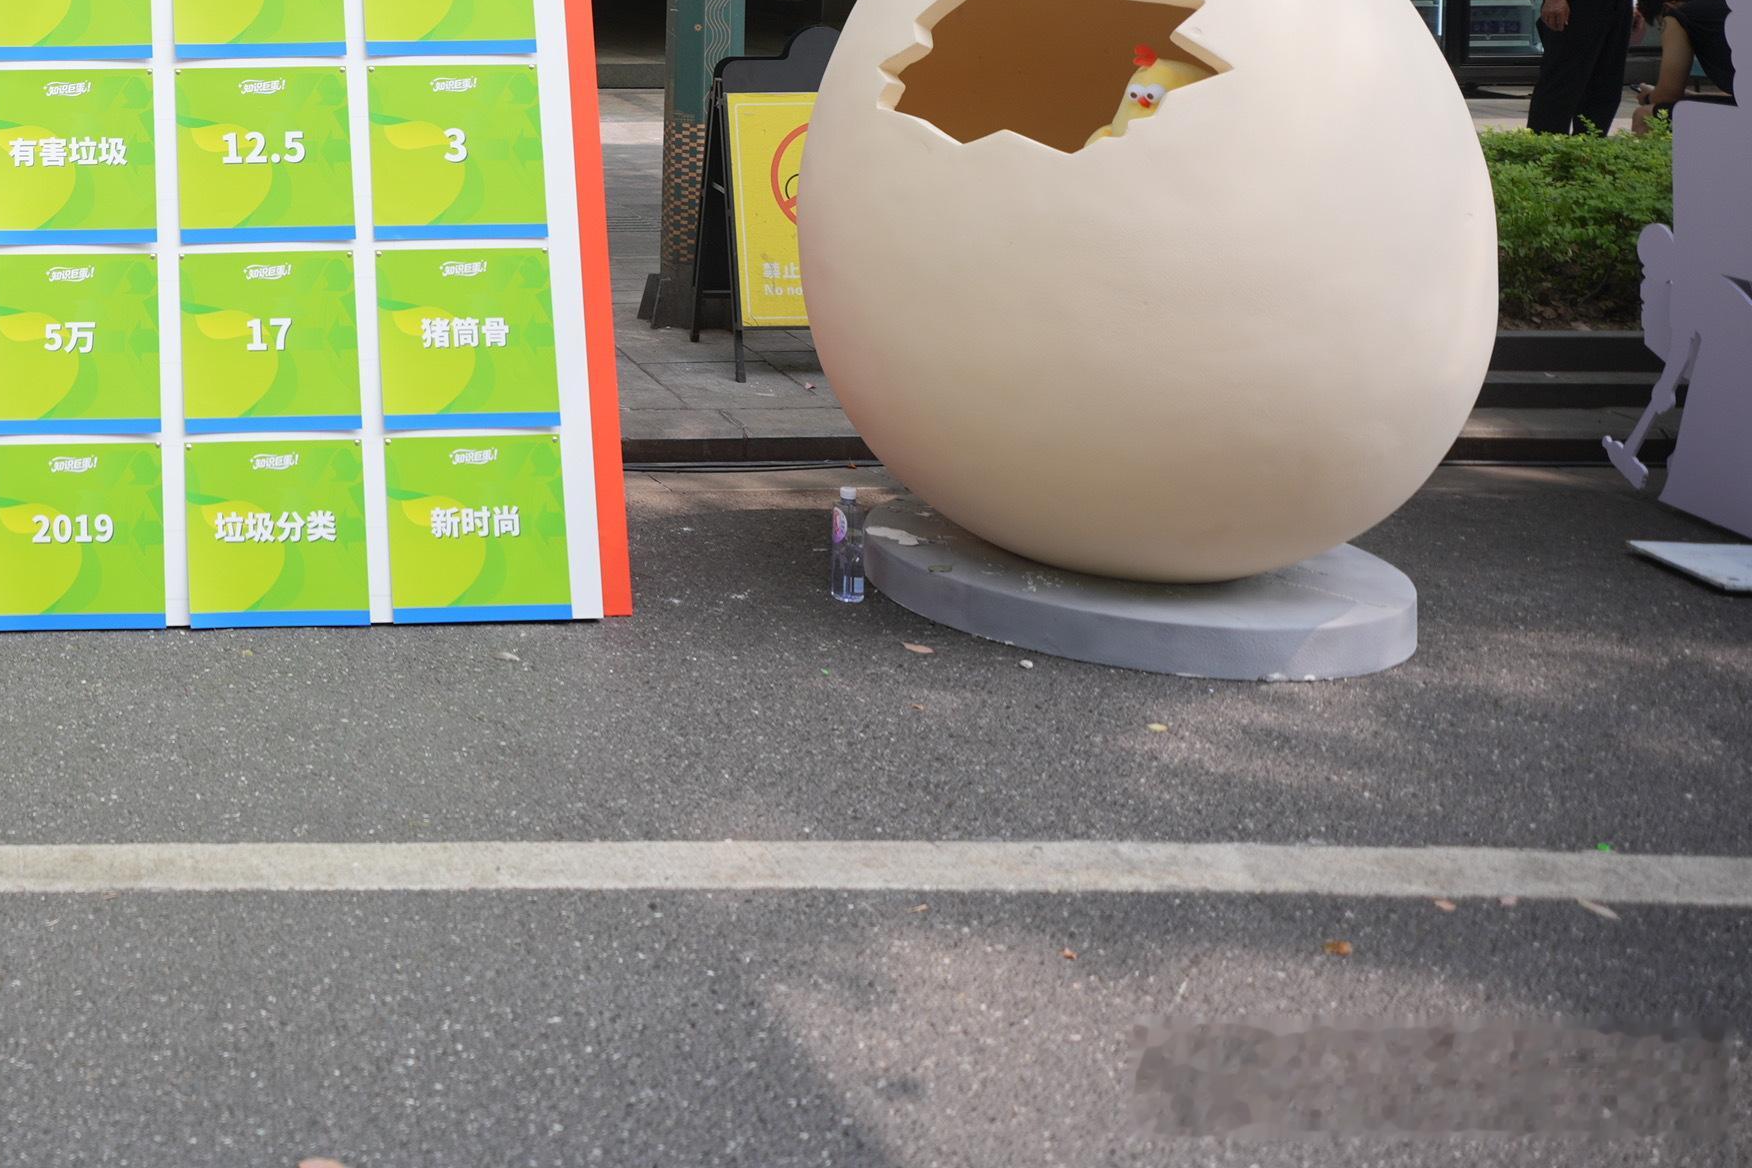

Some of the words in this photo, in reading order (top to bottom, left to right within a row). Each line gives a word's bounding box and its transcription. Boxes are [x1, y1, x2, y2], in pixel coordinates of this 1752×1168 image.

[9, 137, 128, 168] 有害垃圾
[222, 131, 305, 165] 12.5
[444, 128, 468, 163] 3
[764, 284, 784, 296] No
[44, 321, 96, 354] 5万
[247, 317, 293, 352] 17
[421, 317, 510, 349] 猪筒骨
[32, 513, 114, 545] 2019
[215, 511, 337, 544] 垃圾分类
[430, 506, 520, 538] 新时尚
